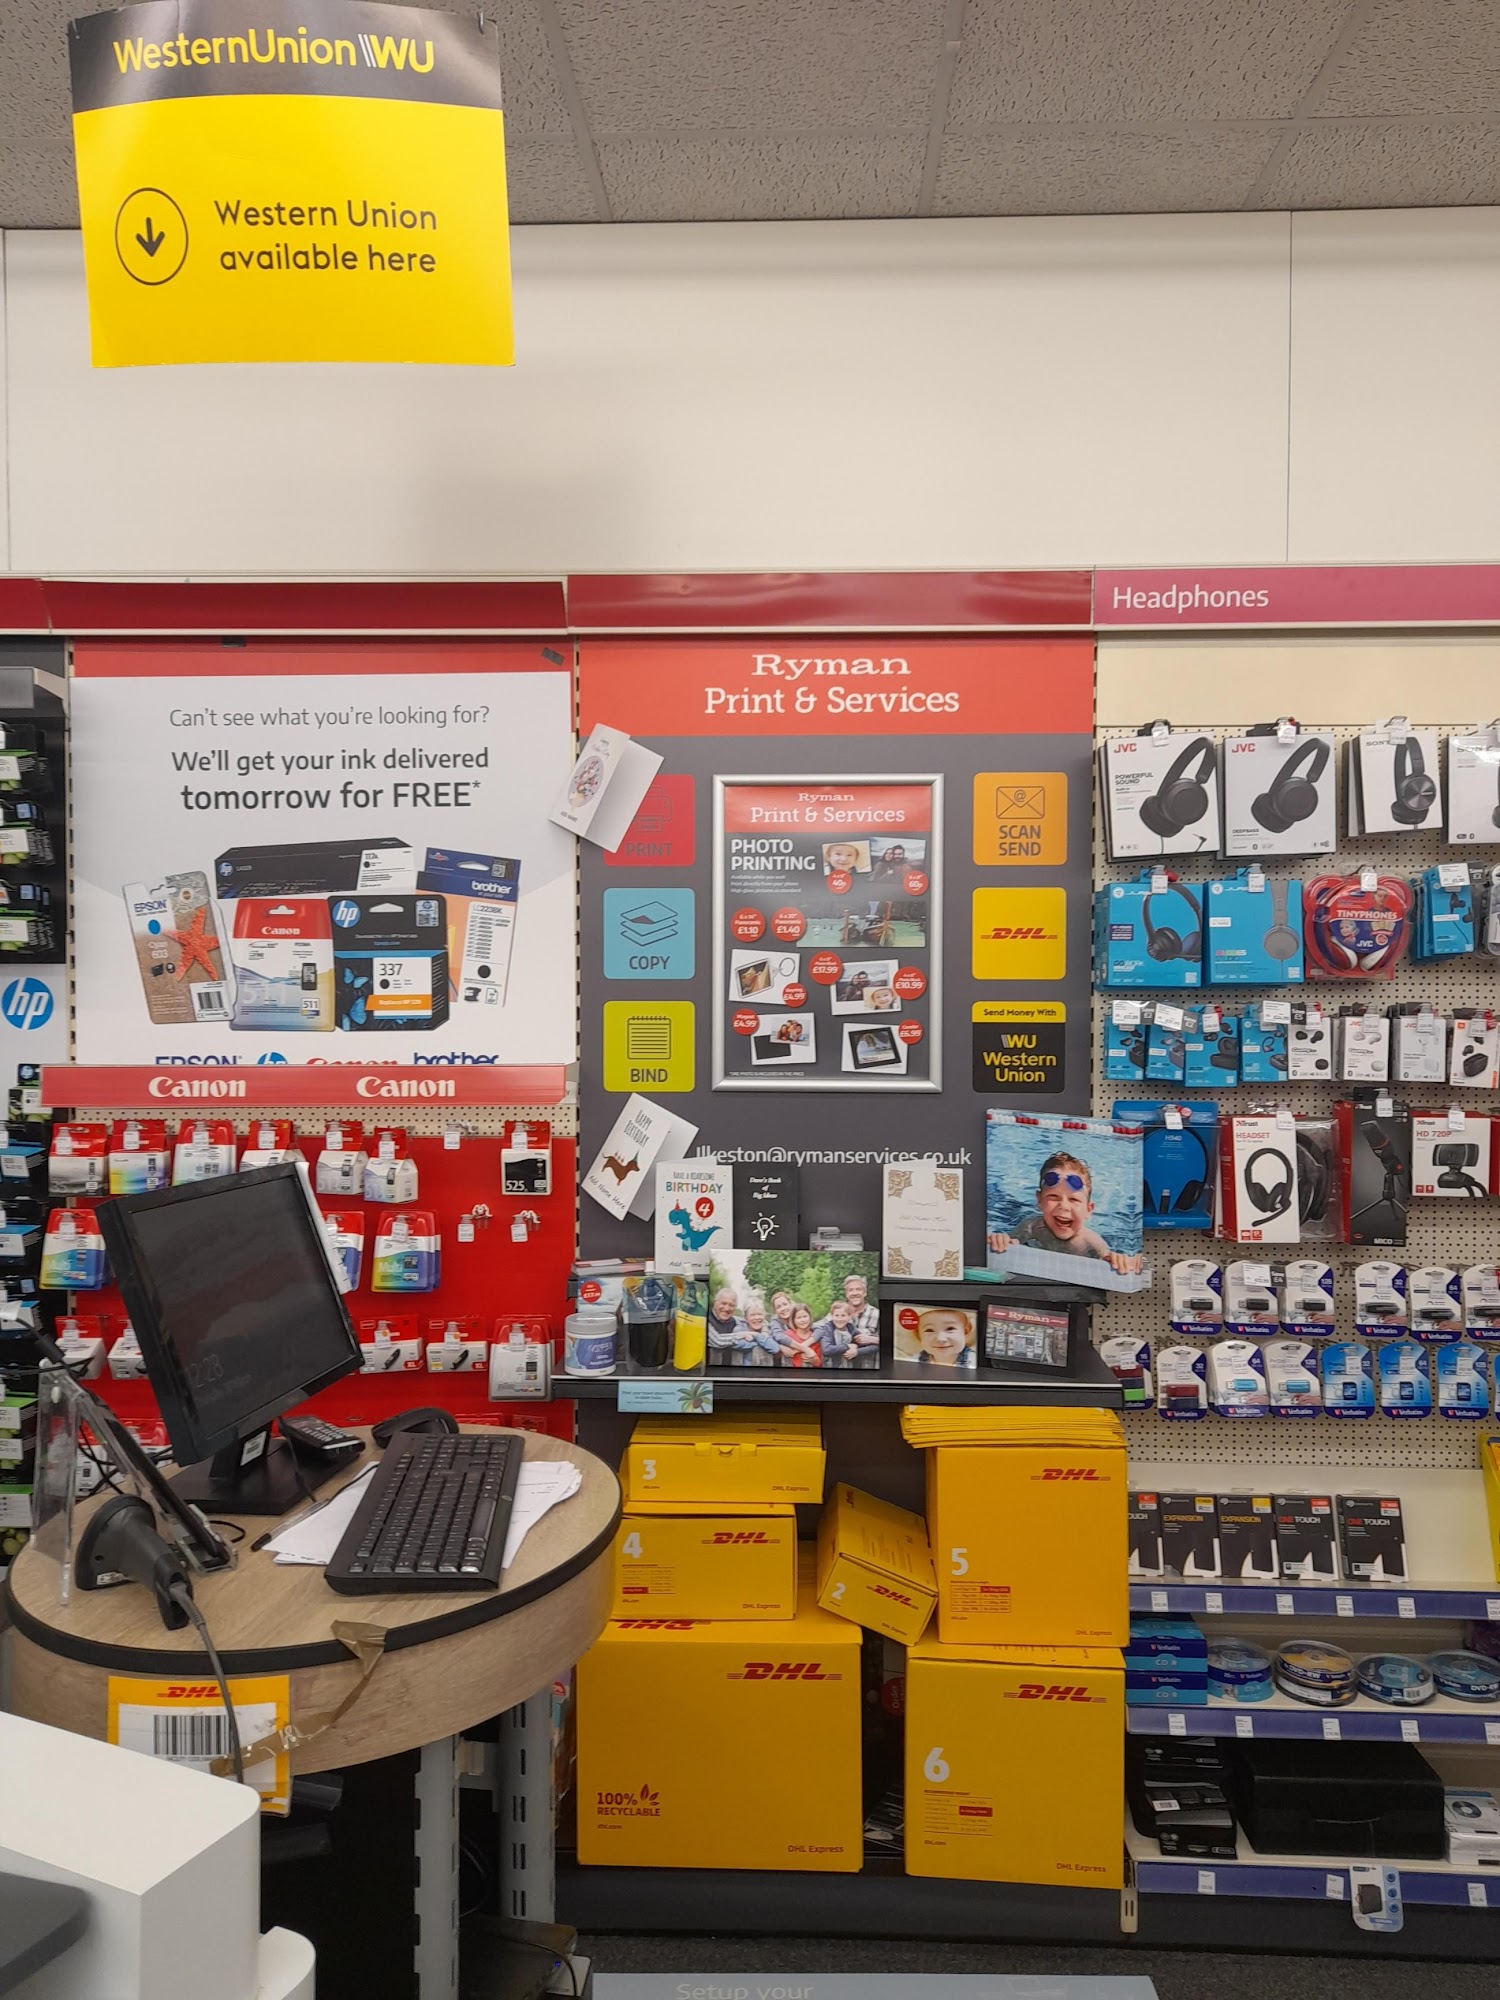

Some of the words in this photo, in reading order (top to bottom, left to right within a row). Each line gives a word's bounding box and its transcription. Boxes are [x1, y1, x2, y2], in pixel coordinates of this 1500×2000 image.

[112, 25, 358, 74] WesternUnion
[371, 34, 436, 74] WU
[214, 200, 337, 227] Western
[347, 200, 438, 230] Union
[219, 243, 359, 271] available
[368, 245, 437, 273] here
[1113, 584, 1269, 613] Headphones
[752, 653, 912, 680] Ryman
[704, 687, 785, 715] Print
[794, 687, 818, 714] &
[827, 687, 960, 714] Services
[222, 711, 255, 727] see
[259, 706, 310, 726] what
[377, 705, 448, 730] looking
[451, 705, 490, 725] for?
[1113, 743, 1138, 754] JVC
[1231, 743, 1256, 753] JVC
[236, 753, 275, 778] get
[281, 753, 335, 777] your
[340, 748, 377, 771] ink
[383, 747, 490, 770] delivered
[1115, 772, 1154, 780] POWERFUL
[181, 784, 330, 810] tomorrow
[339, 782, 384, 809] for
[798, 793, 855, 804] Ryman
[750, 807, 800, 823] Print
[805, 807, 819, 822] &
[823, 807, 906, 823] Services
[998, 825, 1042, 841] SCAN
[625, 842, 673, 858] PRINT
[730, 839, 794, 854] PHOTO
[998, 842, 1042, 857] SEND
[730, 856, 817, 871] PRINTING
[472, 881, 512, 895] brother
[134, 900, 168, 913] EPSON
[335, 900, 360, 929] hp
[1336, 910, 1398, 919] TINYPHONES
[262, 926, 301, 935] Canon
[991, 927, 1047, 940] DHL
[378, 963, 403, 976] 337
[629, 955, 671, 971] COPY
[8, 977, 51, 1030] hp
[303, 1000, 319, 1009] 511
[983, 1008, 1004, 1017] Send
[1006, 1008, 1036, 1019] Money
[1039, 1007, 1057, 1017] With
[1004, 1033, 1037, 1049] WU
[982, 1052, 1057, 1069] Western
[630, 1068, 668, 1083] BIND
[995, 1067, 1045, 1084] Union
[148, 1076, 247, 1098] Canon
[356, 1075, 456, 1098] Canon
[636, 1109, 653, 1131] HAPPY
[623, 1119, 650, 1148] BIRTHDAY
[506, 1180, 525, 1191] 525
[665, 1181, 724, 1194] BIRTHDAY
[598, 1184, 614, 1202] Name
[611, 1195, 627, 1211] Here
[698, 1203, 711, 1214] 4
[1008, 1310, 1051, 1324] Ryman
[643, 1460, 656, 1480] 3
[1042, 1469, 1100, 1482] DHL
[1163, 1515, 1204, 1523] EXPANSION
[1221, 1516, 1262, 1524] EXPANSION
[1279, 1516, 1293, 1524] ONE
[1295, 1516, 1321, 1524] TOUCH
[622, 1532, 643, 1559] 4
[713, 1532, 769, 1544] DHL
[951, 1548, 969, 1576] 5
[832, 1583, 846, 1600] 2
[873, 1585, 913, 1607] DHL
[743, 1662, 827, 1681] DHL
[168, 1686, 219, 1698] DHL
[1017, 1684, 1094, 1704] DHL
[923, 1747, 950, 1783] 6
[597, 1791, 638, 1806] 100%
[597, 1806, 661, 1817] RECYCLABLE
[787, 1844, 807, 1853] DHL
[808, 1845, 844, 1855] Express
[1056, 1862, 1073, 1871] DHL
[1074, 1863, 1106, 1874] Express
[676, 1982, 749, 2000] Setup
[754, 1985, 815, 2000] your
